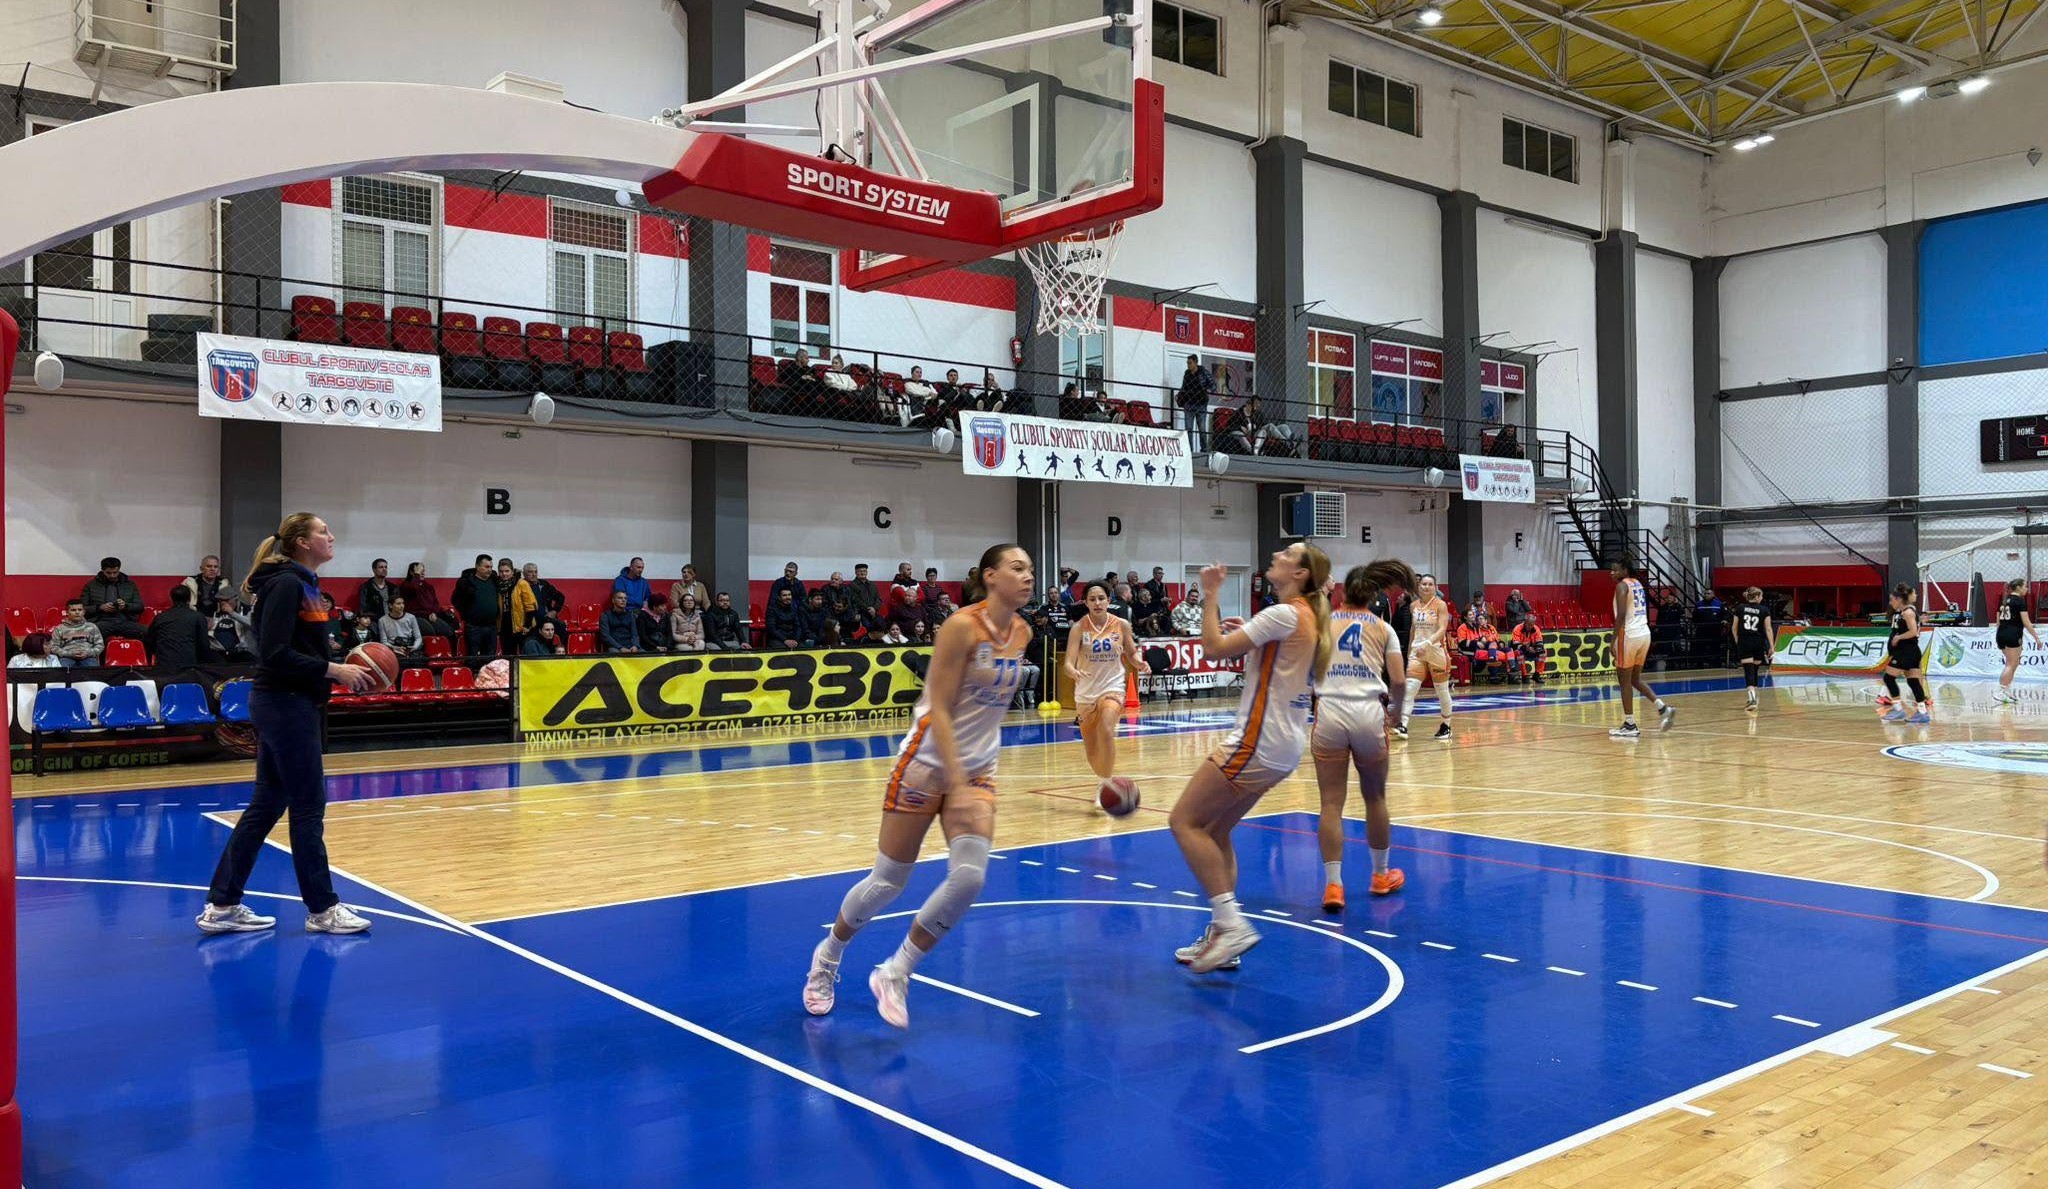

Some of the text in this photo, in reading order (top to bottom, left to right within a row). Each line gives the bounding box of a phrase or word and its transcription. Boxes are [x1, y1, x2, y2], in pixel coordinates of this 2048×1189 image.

[787, 163, 951, 218] SPORT SYSTEM
[262, 349, 317, 367] CLUBUL
[317, 356, 378, 373] SPORTIV
[305, 372, 394, 393] TARGOVISTE
[1010, 422, 1050, 447] CLUBUL
[1050, 427, 1089, 450] SPORTIV
[2016, 426, 2036, 436] HOME
[486, 488, 511, 515] B
[873, 506, 892, 529] C
[1107, 516, 1122, 536] D
[1361, 525, 1372, 544] E
[1515, 532, 1523, 548] F
[1743, 614, 1760, 631] 32
[2000, 605, 2011, 620] 23
[1092, 638, 1112, 653] 26
[1337, 621, 1363, 658] 4
[1788, 638, 1885, 657] CATENA
[992, 657, 1018, 687] 77
[12, 751, 169, 772] ORGIN OF COFFEE
